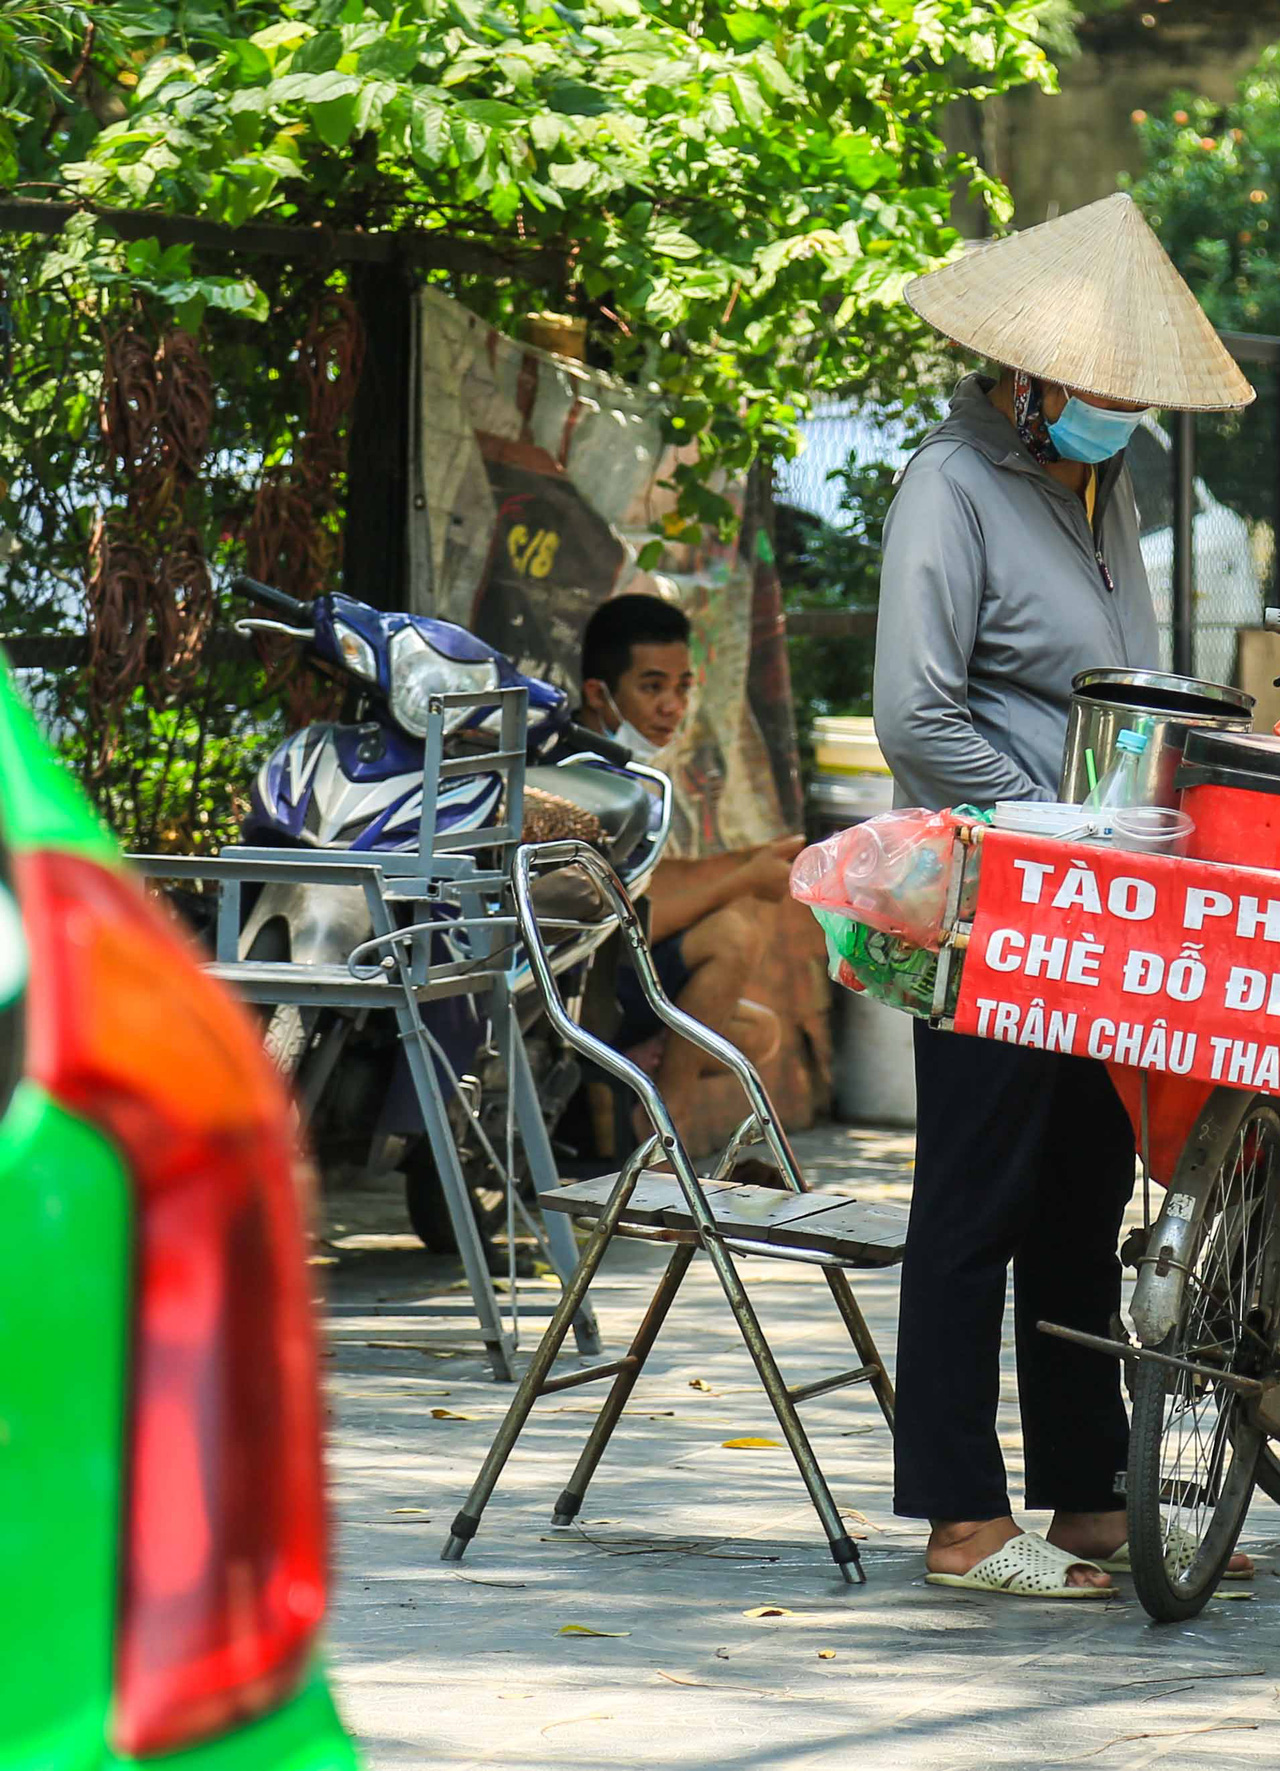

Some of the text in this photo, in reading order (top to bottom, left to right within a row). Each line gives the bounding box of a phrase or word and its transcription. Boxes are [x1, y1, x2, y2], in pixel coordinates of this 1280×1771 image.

[1013, 858, 1156, 921] TÀO
[984, 928, 1105, 986] CHÈ
[1121, 941, 1207, 1003] ĐỖ
[976, 998, 1079, 1054] TRÂN
[1087, 1017, 1199, 1075] CHÂU
